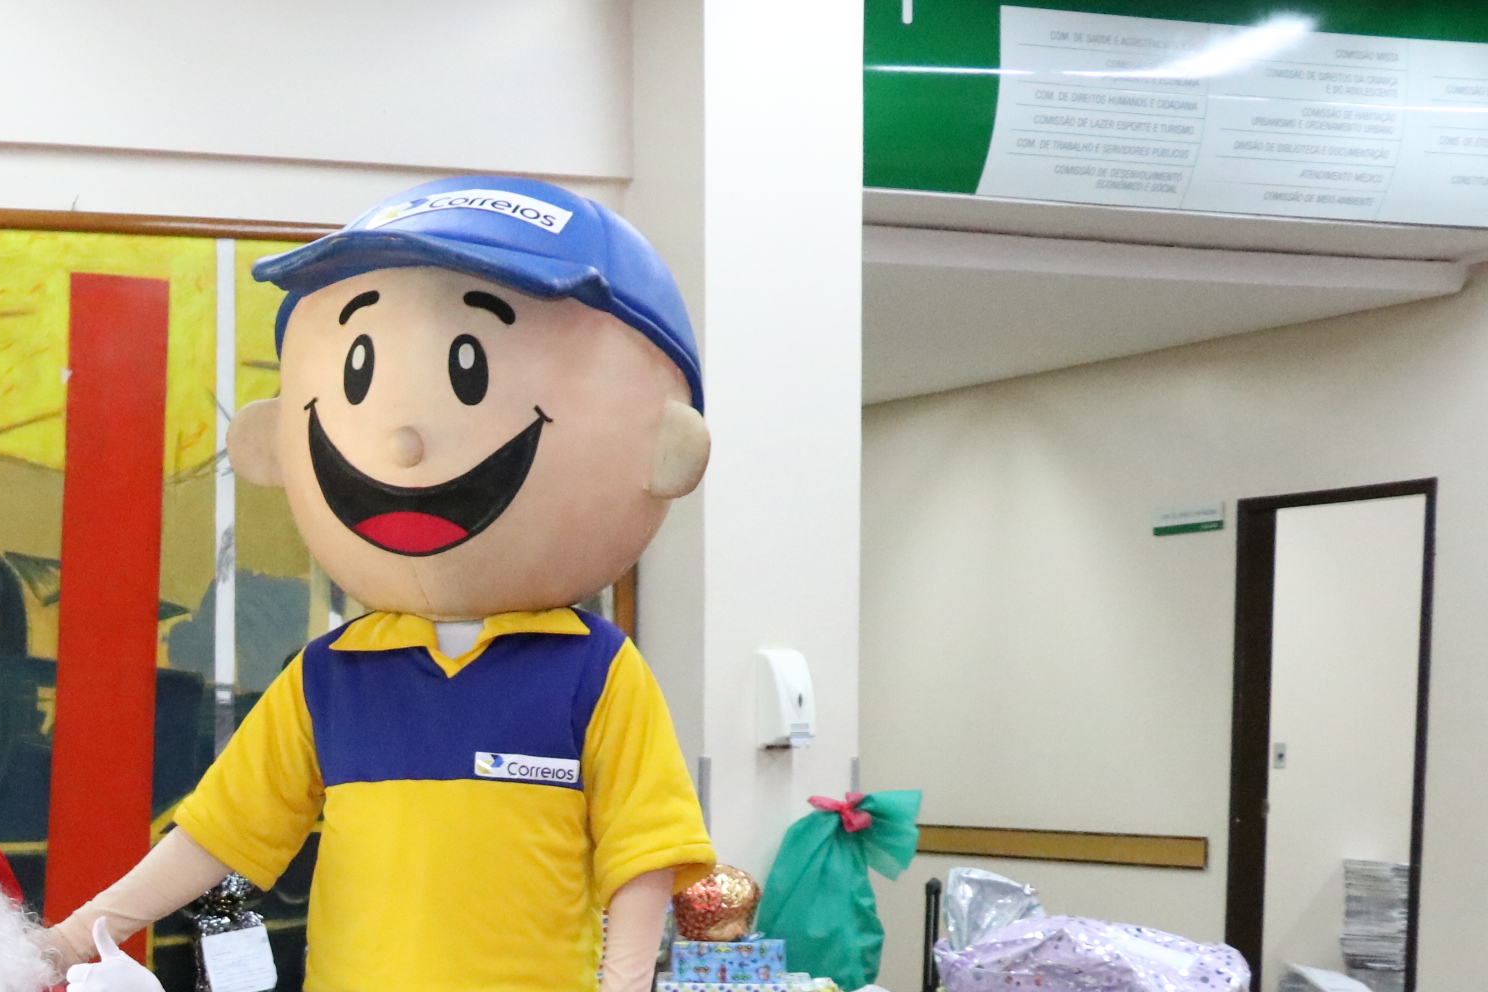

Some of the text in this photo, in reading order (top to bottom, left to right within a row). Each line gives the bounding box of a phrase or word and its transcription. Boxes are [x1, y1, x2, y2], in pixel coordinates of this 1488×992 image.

[1058, 91, 1069, 102] DE
[1071, 93, 1106, 106] DIREITOS
[1108, 95, 1148, 108] HUMANOS
[1149, 98, 1155, 108] E
[1343, 109, 1353, 119] DE
[1034, 114, 1195, 135] COMISSÃO DE LAZER ESPORTE E TURISMO
[1039, 139, 1050, 150] DE
[1053, 139, 1093, 152] TRABALHO
[1095, 143, 1100, 152] E
[1102, 143, 1150, 157] SERVIDORES
[1265, 142, 1275, 152] DE
[1097, 167, 1108, 177] DE
[429, 196, 556, 227] Correios
[507, 762, 574, 780] Correios
